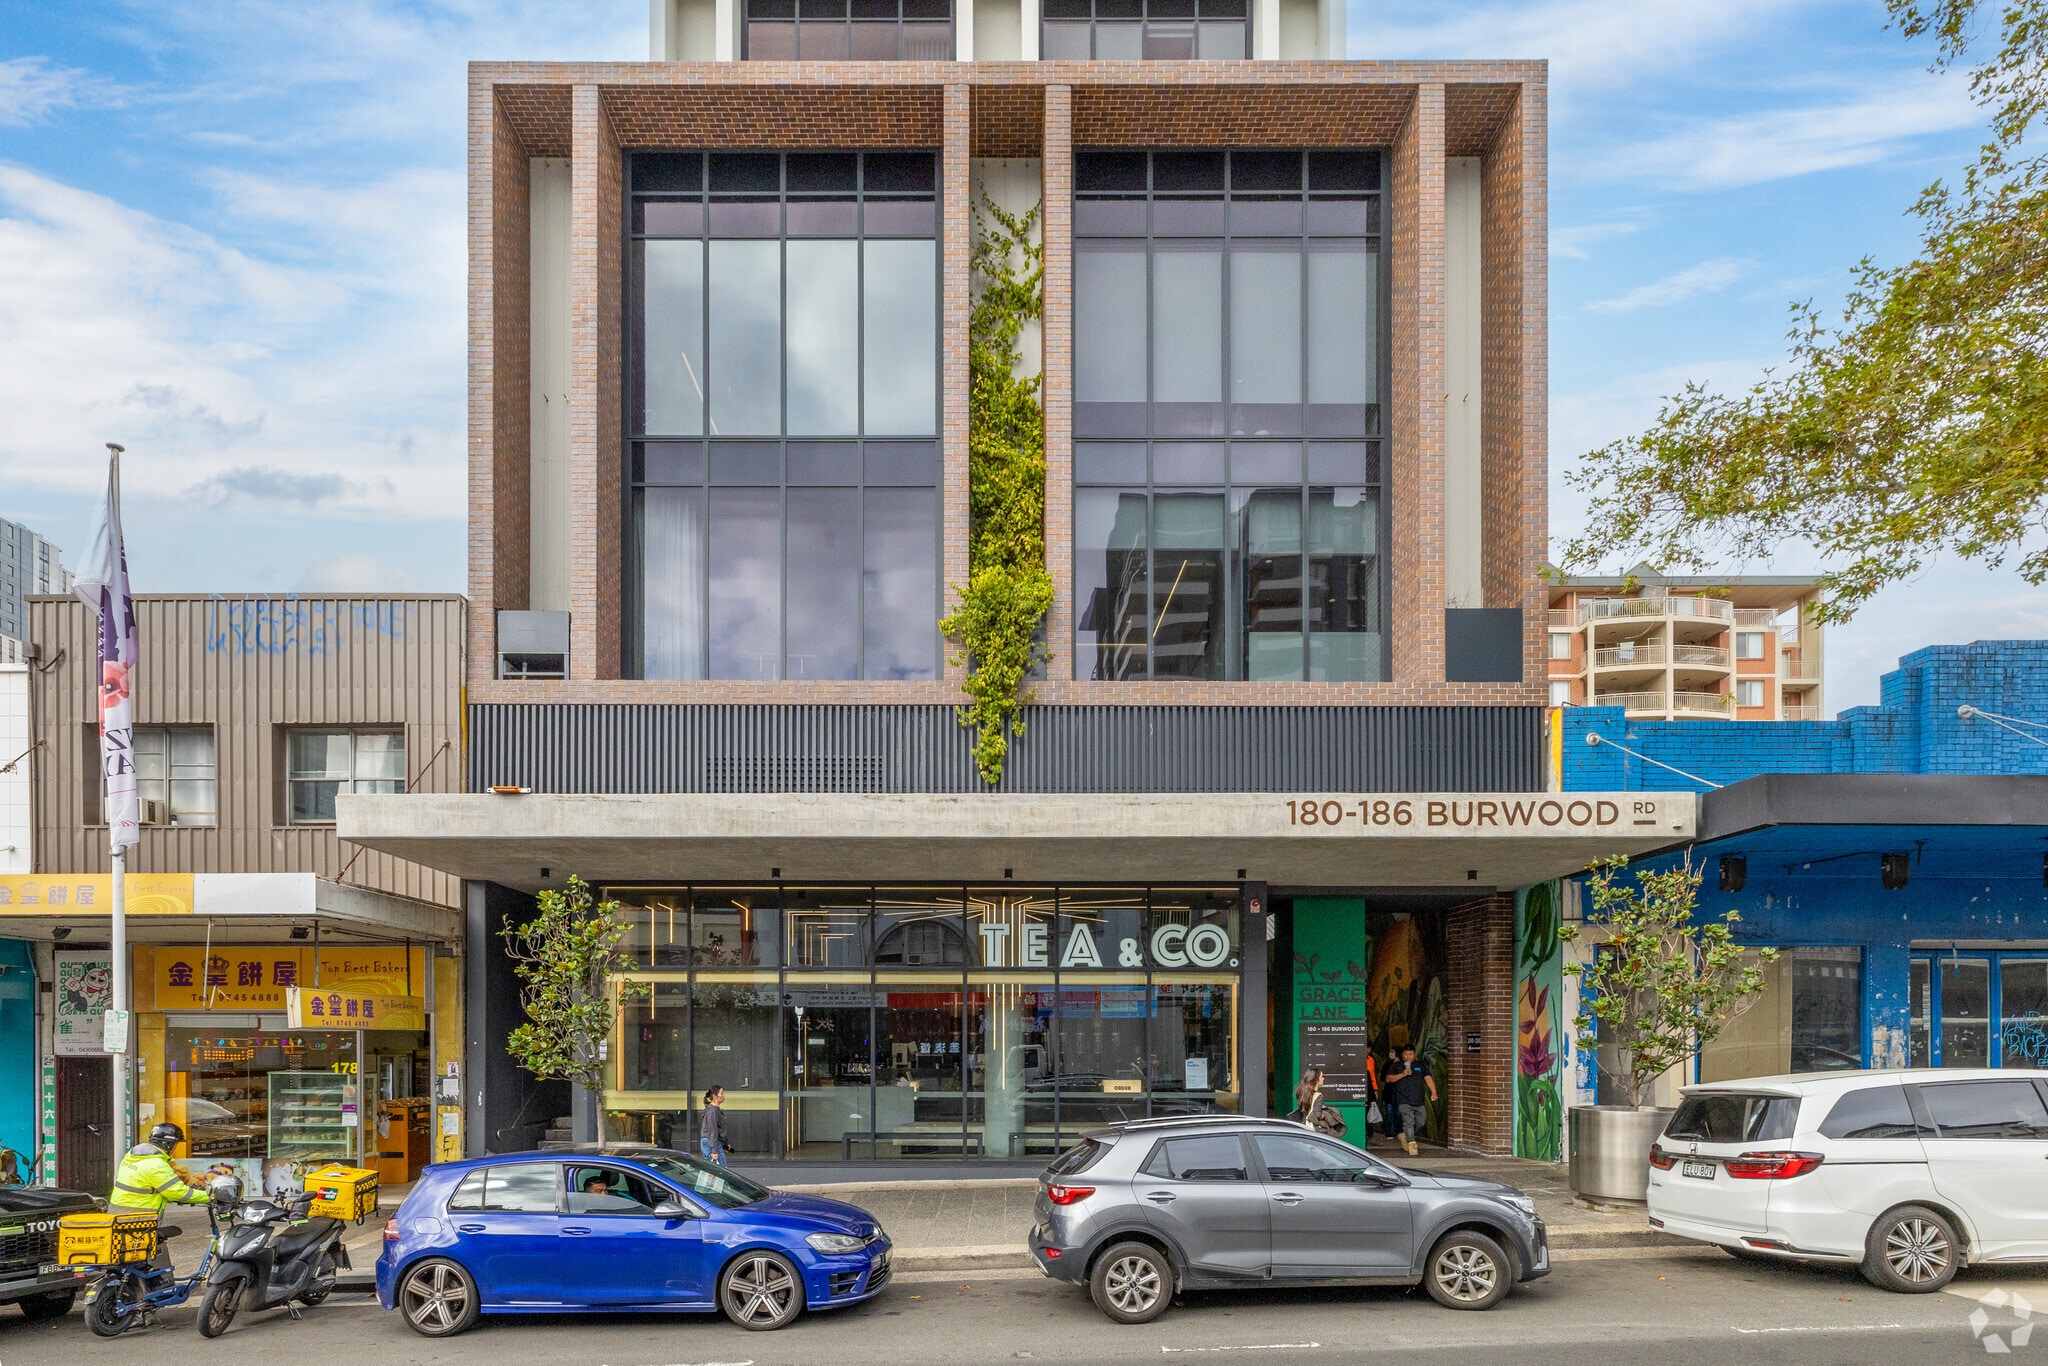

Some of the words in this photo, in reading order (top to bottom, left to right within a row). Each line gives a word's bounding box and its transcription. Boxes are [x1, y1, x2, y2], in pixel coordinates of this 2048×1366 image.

[1286, 801, 1413, 827] 180-186
[1427, 801, 1619, 827] BURWOOD
[1633, 802, 1656, 815] RD
[979, 923, 1104, 967] TEA
[1118, 937, 1143, 967] &
[1151, 923, 1239, 967] CO.
[321, 961, 340, 976] Top
[344, 960, 370, 973] Best
[251, 993, 280, 1002] 4888
[1300, 987, 1362, 1001] GRACE
[117, 1011, 127, 1024] P
[1300, 1005, 1349, 1019] LANE
[331, 1062, 358, 1074] 178
